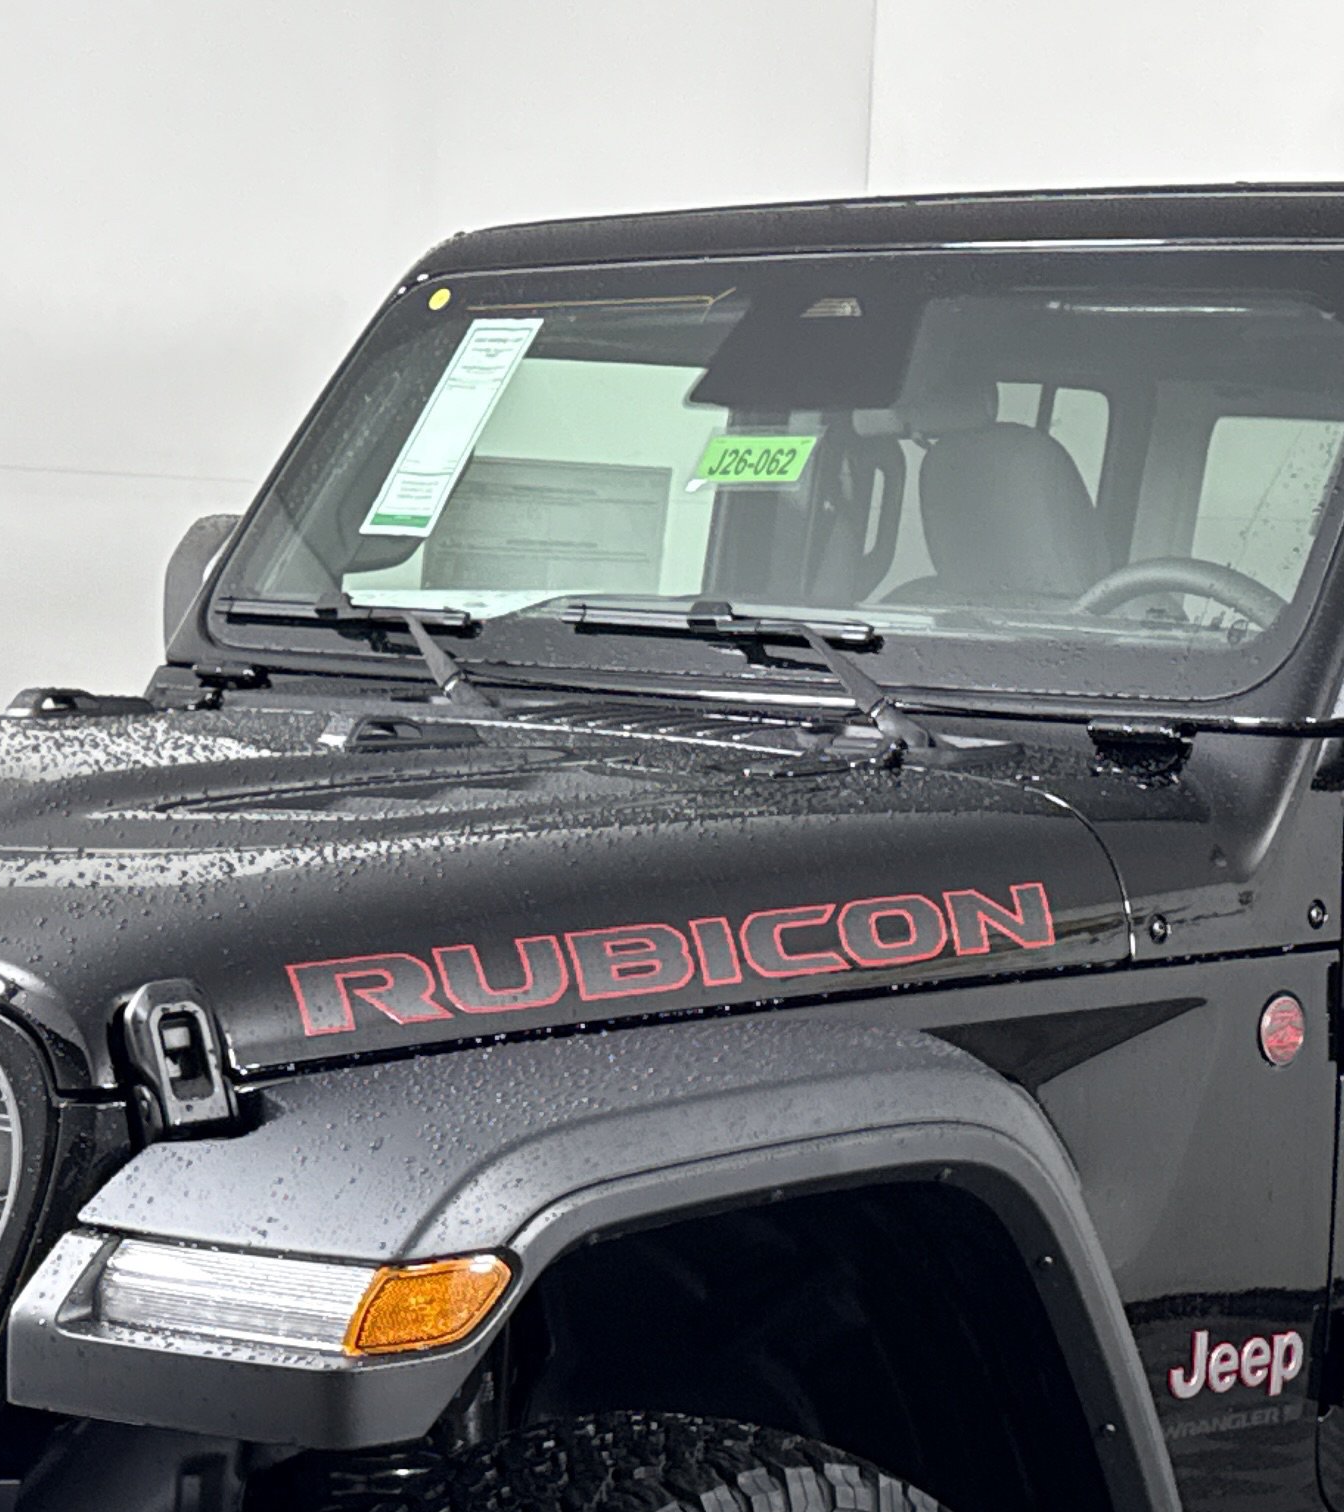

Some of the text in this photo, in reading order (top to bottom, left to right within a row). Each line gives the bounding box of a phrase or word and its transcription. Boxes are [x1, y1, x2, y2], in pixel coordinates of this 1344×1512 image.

[707, 448, 797, 476] J26-062
[285, 882, 1056, 1036] RUBICON
[1167, 1329, 1304, 1399] Jeep
